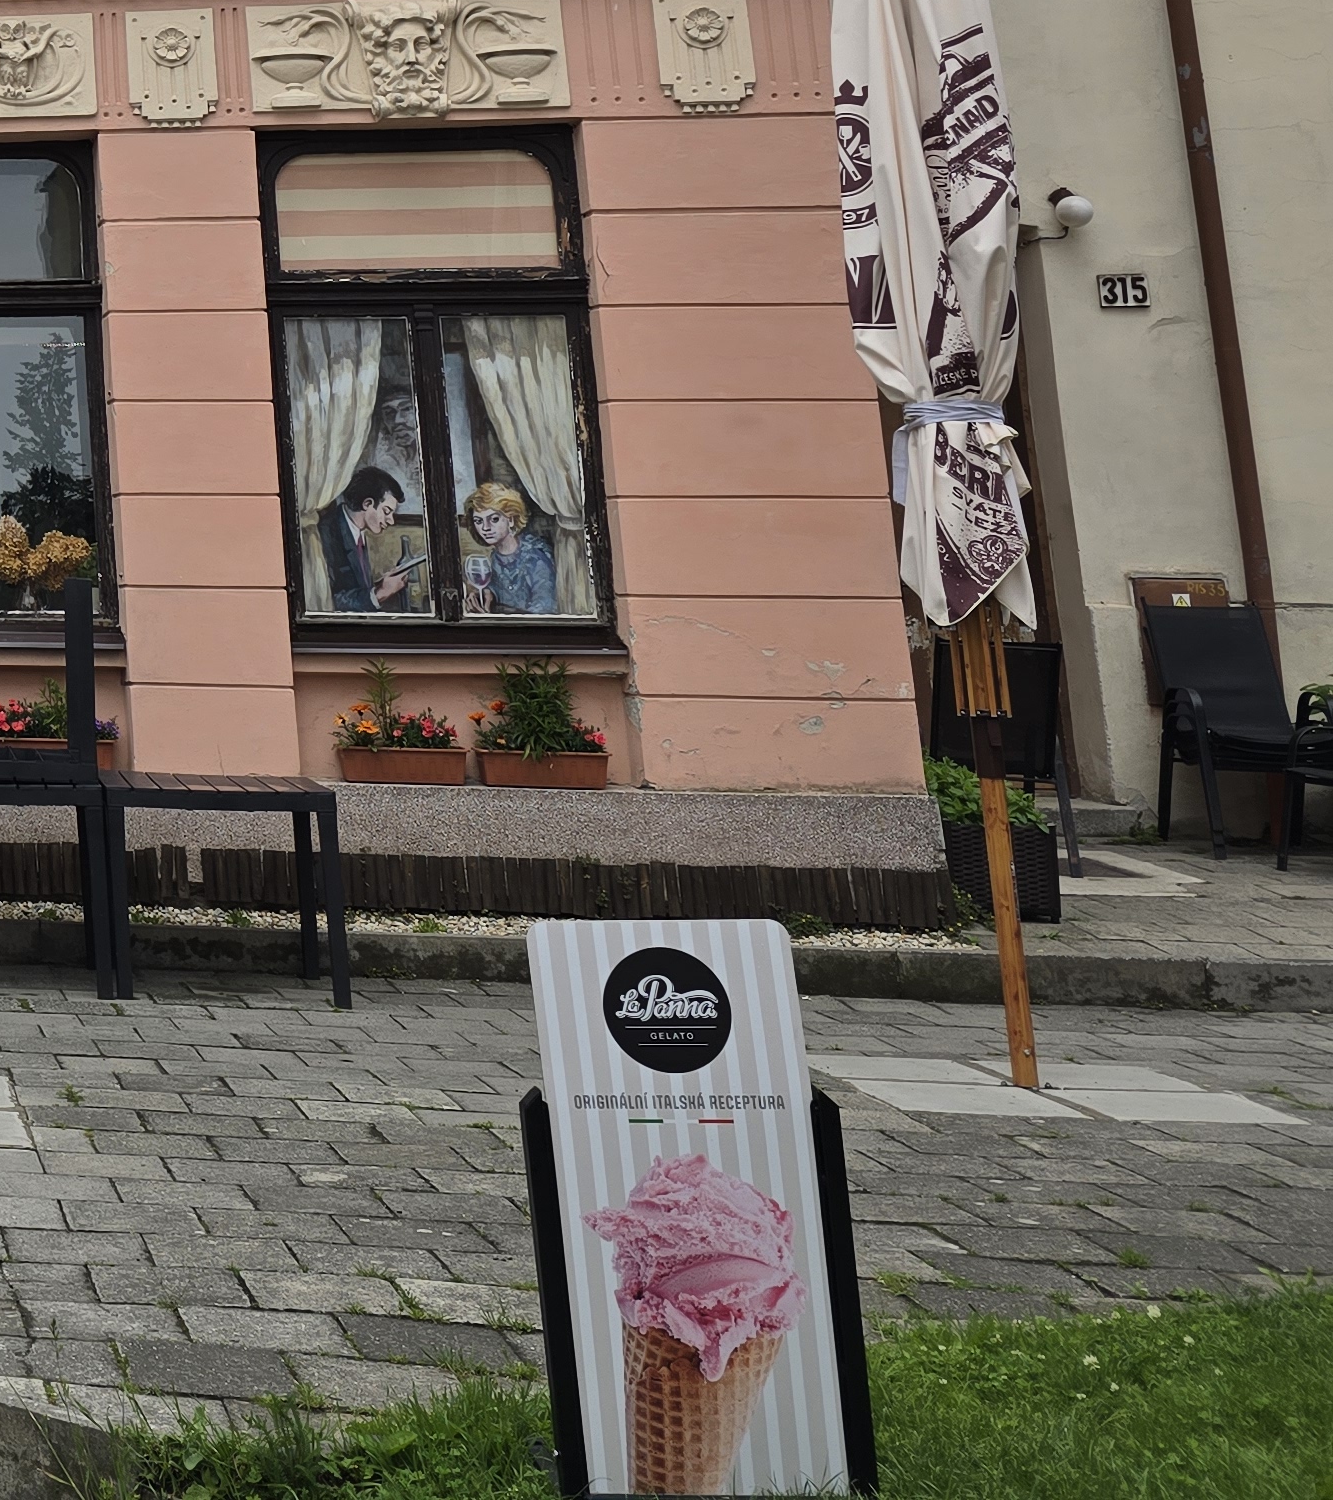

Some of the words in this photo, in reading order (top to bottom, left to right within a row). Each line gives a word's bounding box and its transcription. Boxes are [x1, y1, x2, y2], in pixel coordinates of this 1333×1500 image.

[1101, 276, 1148, 305] 315
[637, 974, 719, 1021] Panna
[649, 1032, 694, 1040] GELATO
[574, 1092, 649, 1110] ORIGINÁLNÍ
[652, 1092, 705, 1110] ITALSKÁ
[709, 1094, 786, 1110] RECEPTURA
